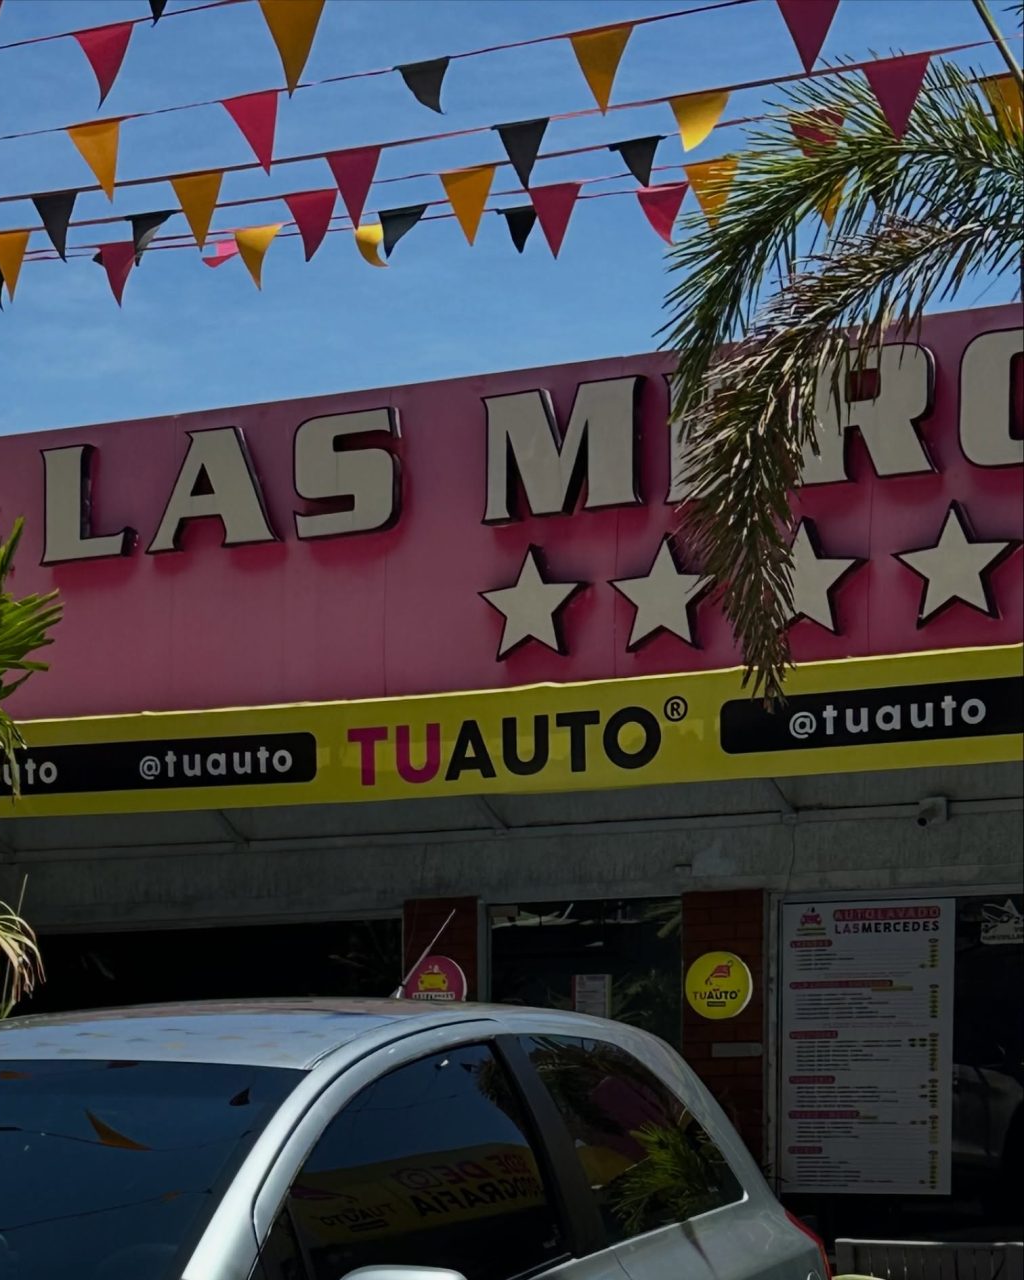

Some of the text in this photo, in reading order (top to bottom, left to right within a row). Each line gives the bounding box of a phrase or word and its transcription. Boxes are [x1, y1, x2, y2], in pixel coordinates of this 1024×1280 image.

[40, 406, 401, 566] LAS
[788, 695, 987, 739] @tuauto
[138, 745, 293, 780] @tuauto
[835, 907, 940, 920] AUTOLAVADO
